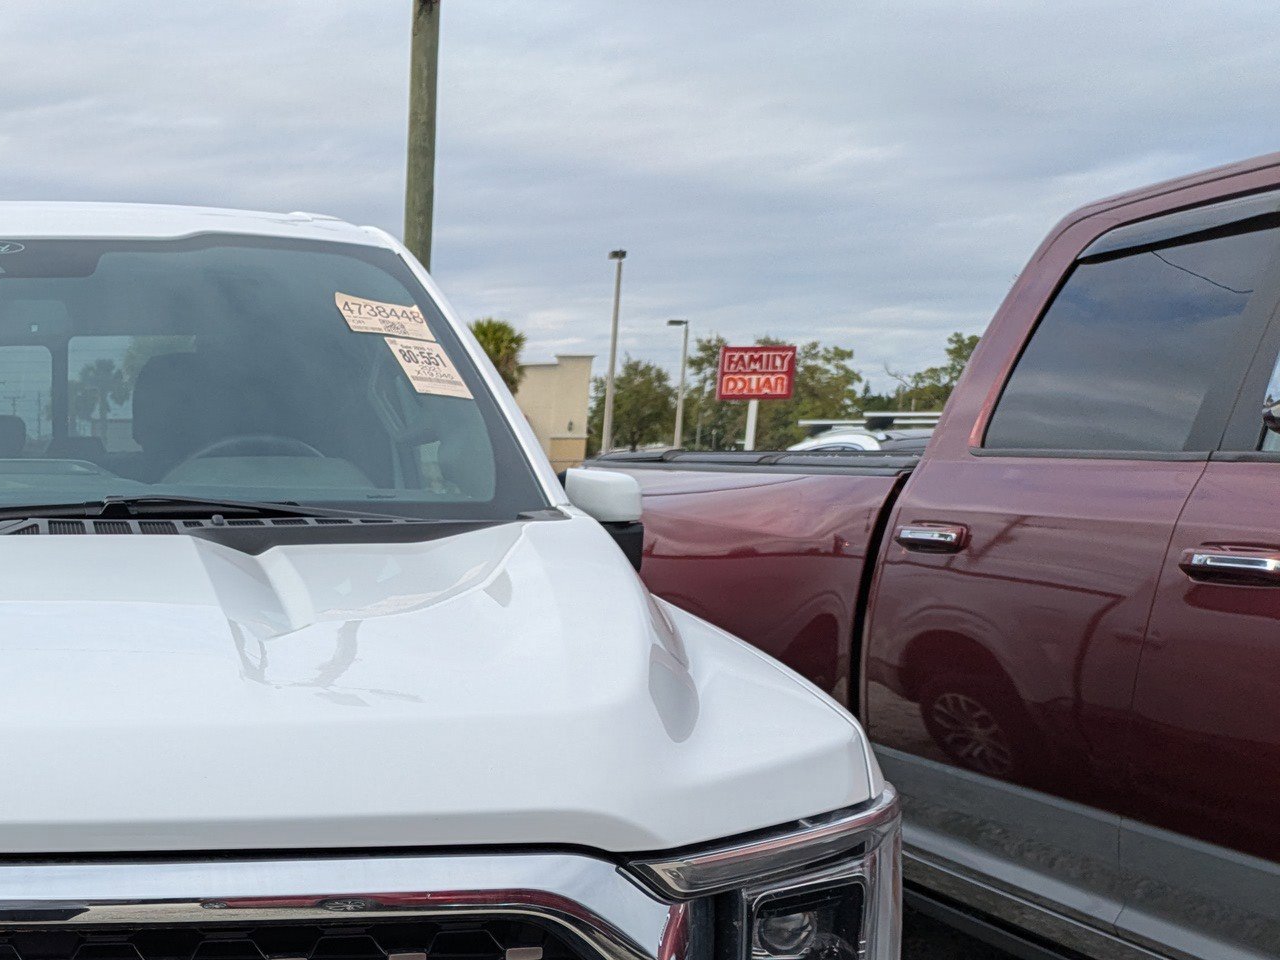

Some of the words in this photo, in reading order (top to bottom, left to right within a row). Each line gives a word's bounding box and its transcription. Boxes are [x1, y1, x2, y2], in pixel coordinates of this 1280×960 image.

[342, 301, 424, 324] 4738448
[398, 348, 447, 368] 80:551
[724, 351, 794, 373] FAMILY
